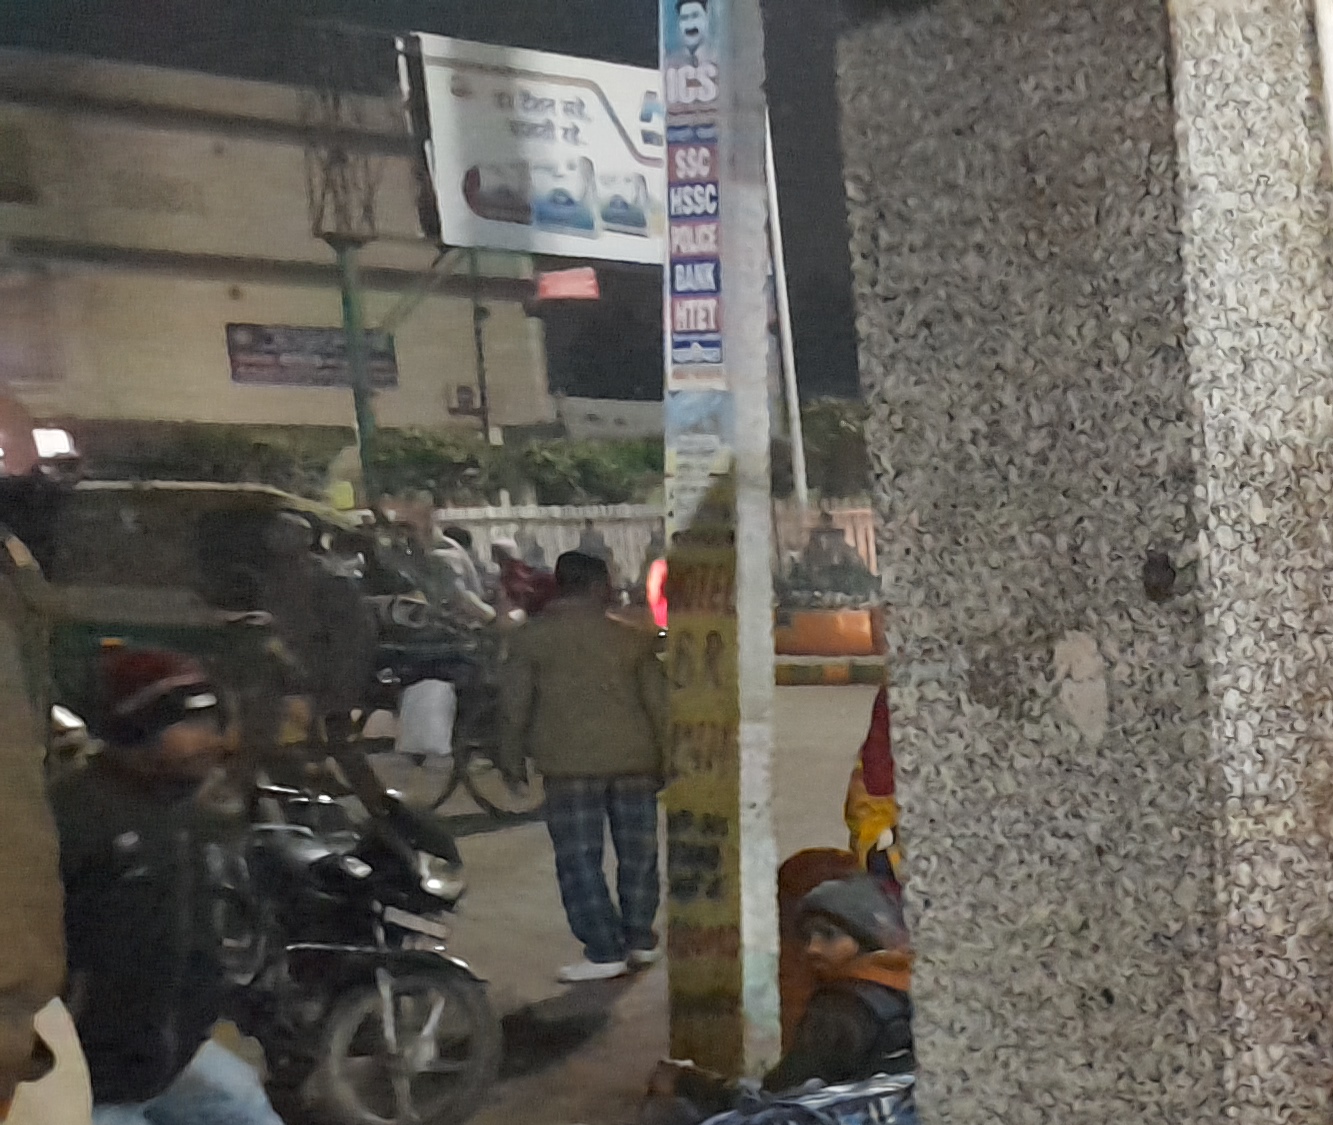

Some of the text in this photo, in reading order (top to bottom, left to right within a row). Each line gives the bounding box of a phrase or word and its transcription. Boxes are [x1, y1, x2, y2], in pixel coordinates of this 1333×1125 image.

[666, 64, 719, 105] ICS
[675, 147, 712, 180] SSC
[670, 184, 719, 218] HSSC
[674, 262, 719, 292] BANK
